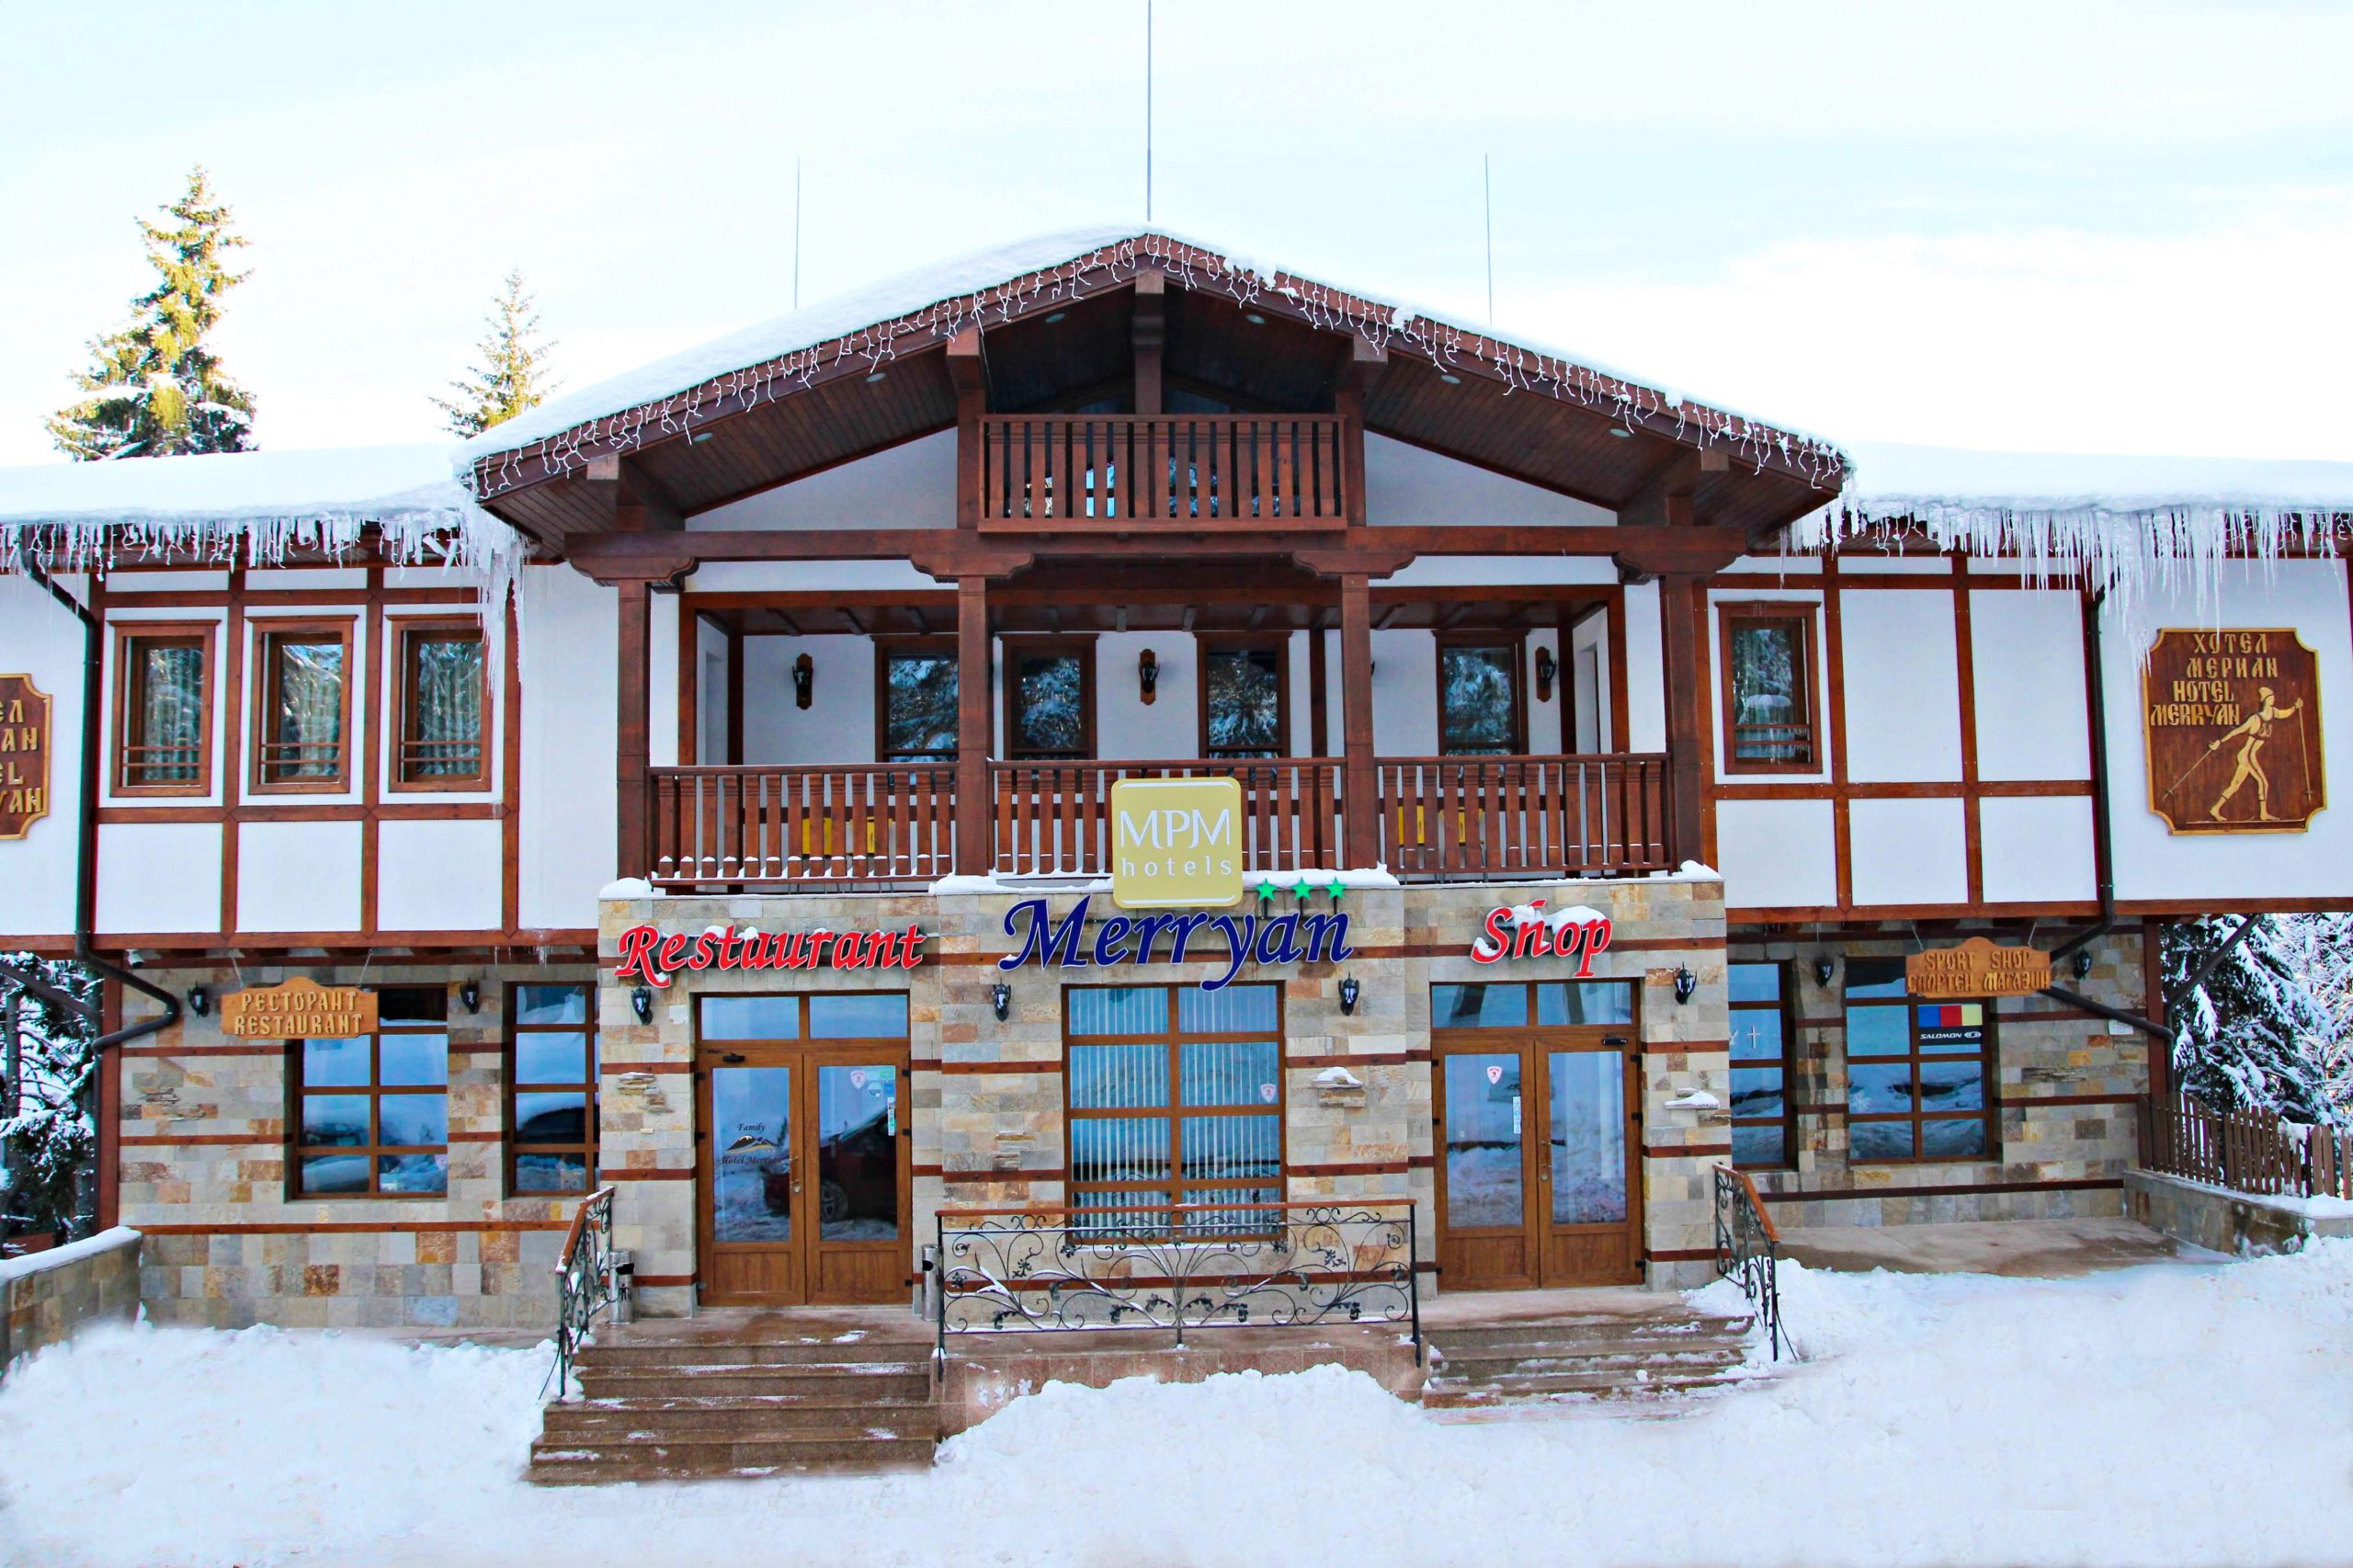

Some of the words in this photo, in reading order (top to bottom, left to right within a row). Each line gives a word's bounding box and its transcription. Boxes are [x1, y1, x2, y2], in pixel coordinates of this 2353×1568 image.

[2193, 632, 2267, 653] ХОТЕЛ
[2173, 680, 2234, 702] HOTEL
[2150, 703, 2240, 726] MERRYAN
[1120, 808, 1231, 849] MPM
[1121, 855, 1233, 878] hotels
[998, 894, 1354, 992] Merryan
[613, 922, 926, 989] Restaurant
[1926, 950, 1975, 971] SPORT
[1991, 949, 2031, 970] SHOP
[1908, 971, 1973, 993] СПОРТЕН
[241, 991, 357, 1012] РЕСТОРАНТ
[234, 1013, 362, 1035] RESTAURANT
[737, 1122, 765, 1133] Family
